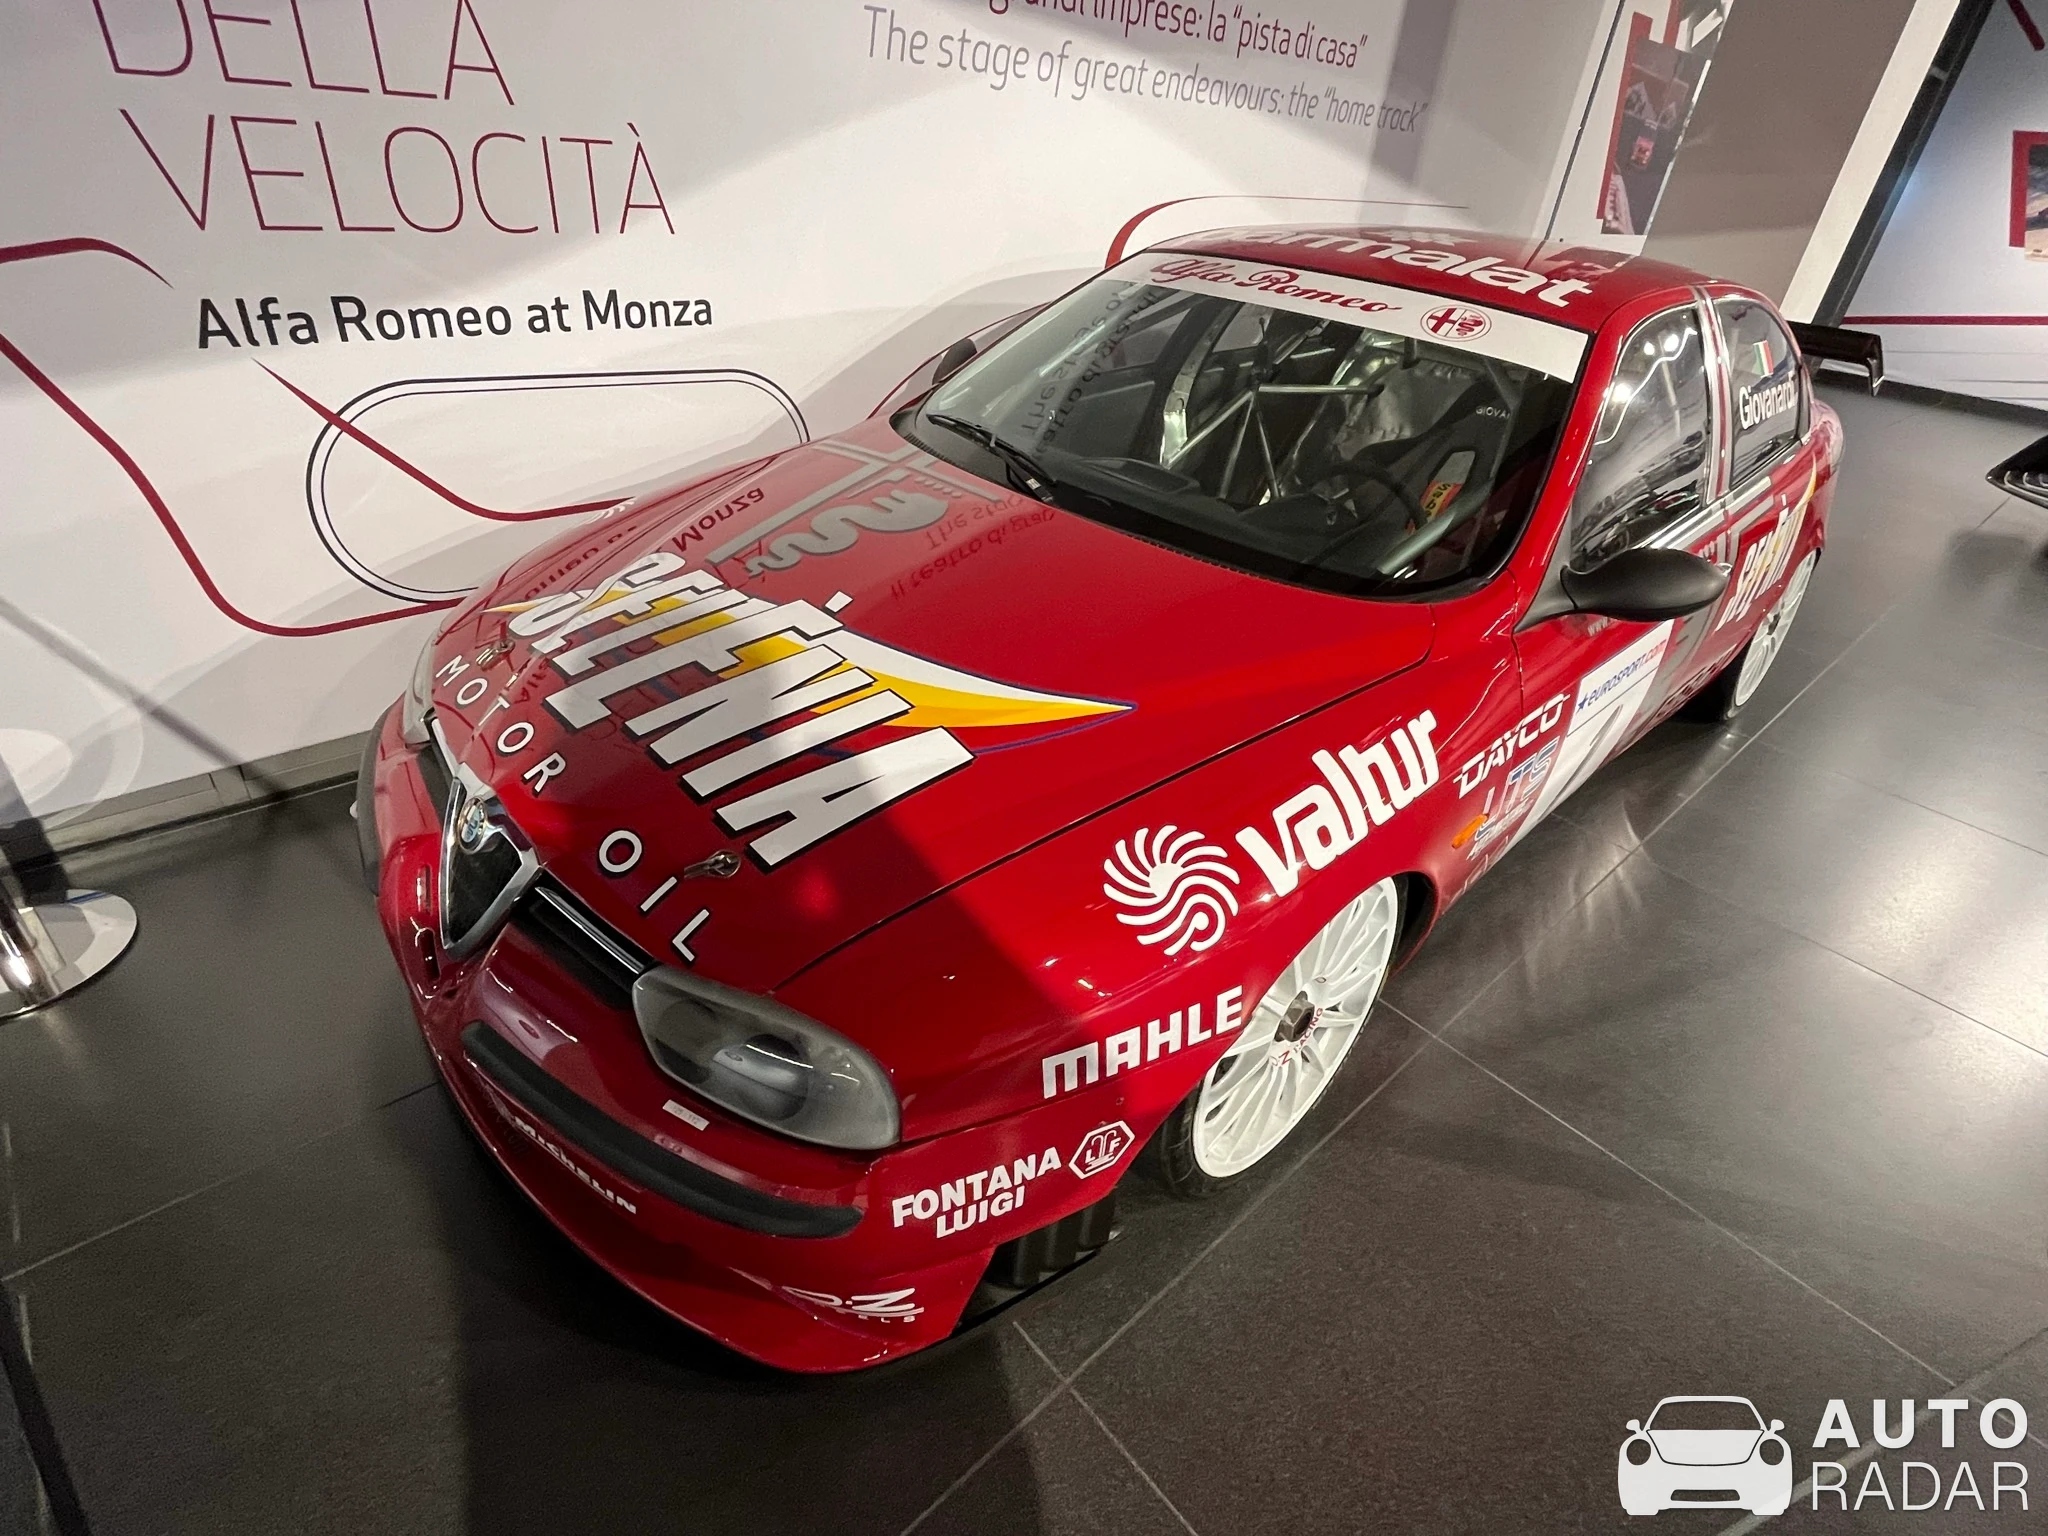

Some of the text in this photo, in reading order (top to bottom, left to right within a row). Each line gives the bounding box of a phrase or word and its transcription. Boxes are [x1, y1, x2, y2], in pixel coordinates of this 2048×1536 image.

[92, 0, 514, 105] DELLA
[863, 5, 928, 64] The
[937, 29, 1029, 91] stage
[1037, 40, 1072, 98] of
[1071, 57, 1148, 101] great
[1151, 63, 1284, 115] endeavours:
[1288, 81, 1319, 119] the
[1207, 0, 1227, 42] la
[1295, 21, 1315, 60] di
[120, 108, 675, 235] VELOCITÀ
[198, 289, 713, 349] Alfa Romeo at Monza
[1150, 259, 1403, 312] Alfa Romeo
[435, 654, 567, 793] MOTOR
[1453, 693, 1571, 799] DAYCO
[1235, 709, 1440, 897] valtur
[598, 829, 710, 962] OIL
[1042, 985, 1244, 1099] MAHLE
[892, 1146, 1062, 1228] FONTANA
[936, 1185, 1025, 1238] LUIGI
